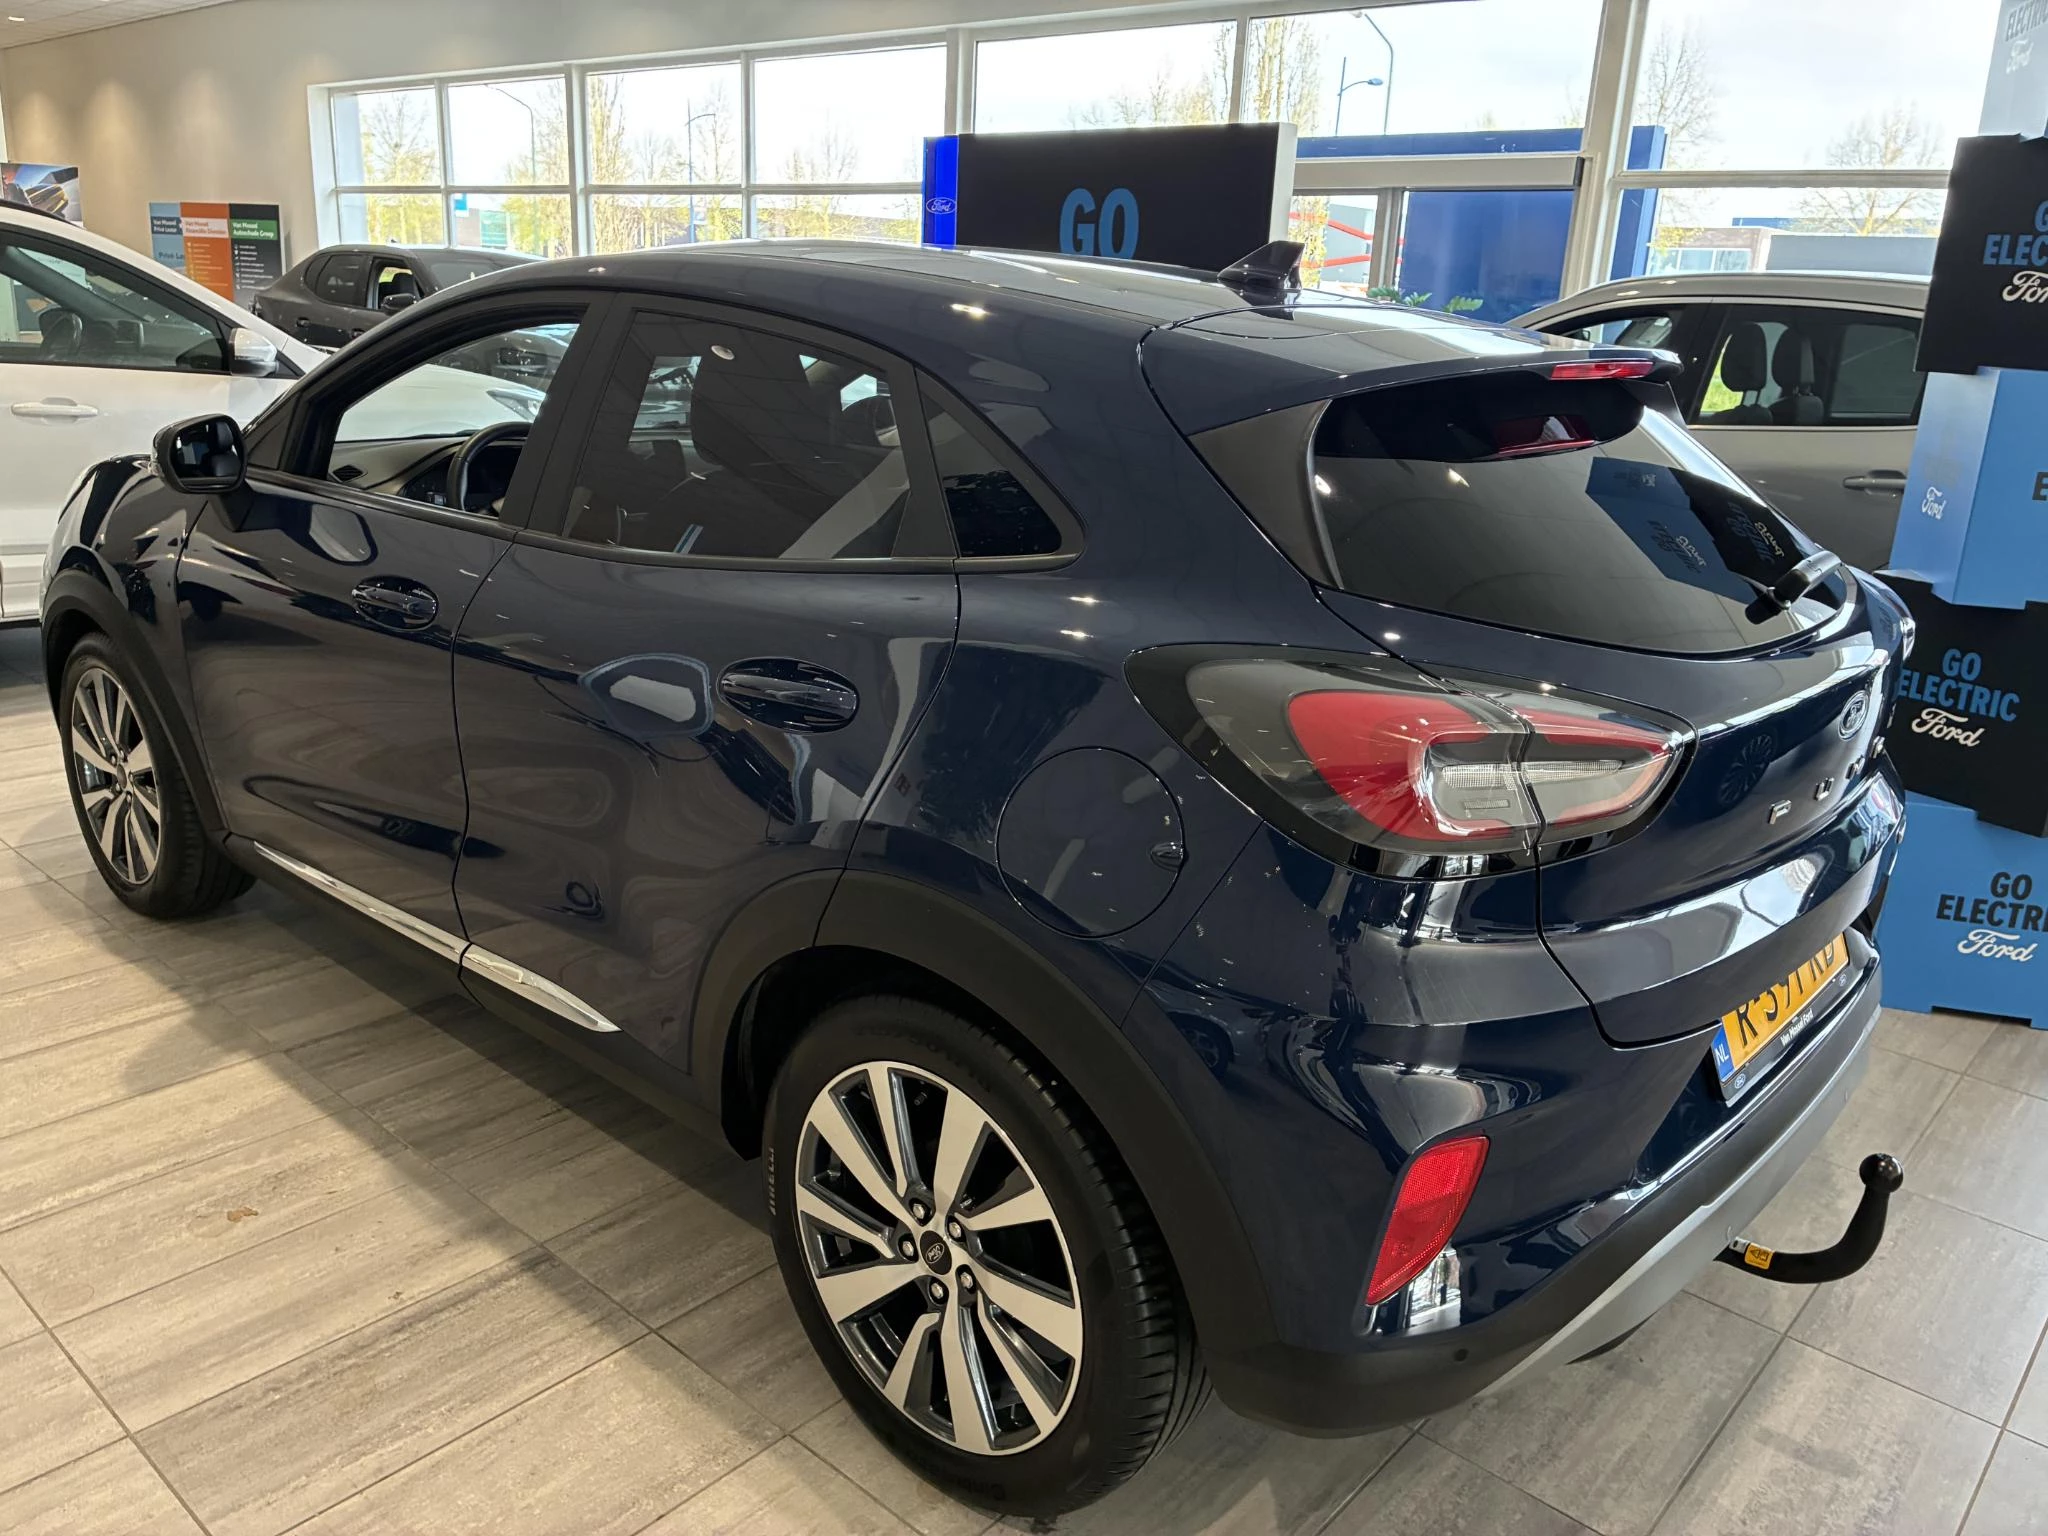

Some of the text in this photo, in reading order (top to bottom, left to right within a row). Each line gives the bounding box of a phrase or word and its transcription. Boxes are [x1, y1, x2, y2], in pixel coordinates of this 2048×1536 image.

[1060, 187, 1139, 260] GO
[1922, 486, 1947, 519] Ford
[1942, 648, 1982, 681] GO
[1897, 669, 2020, 722] ELECTRIC
[1911, 707, 1985, 747] Ford
[1990, 871, 2033, 901] GO
[1957, 929, 2039, 962] Ford
[1715, 1043, 1730, 1066] NL
